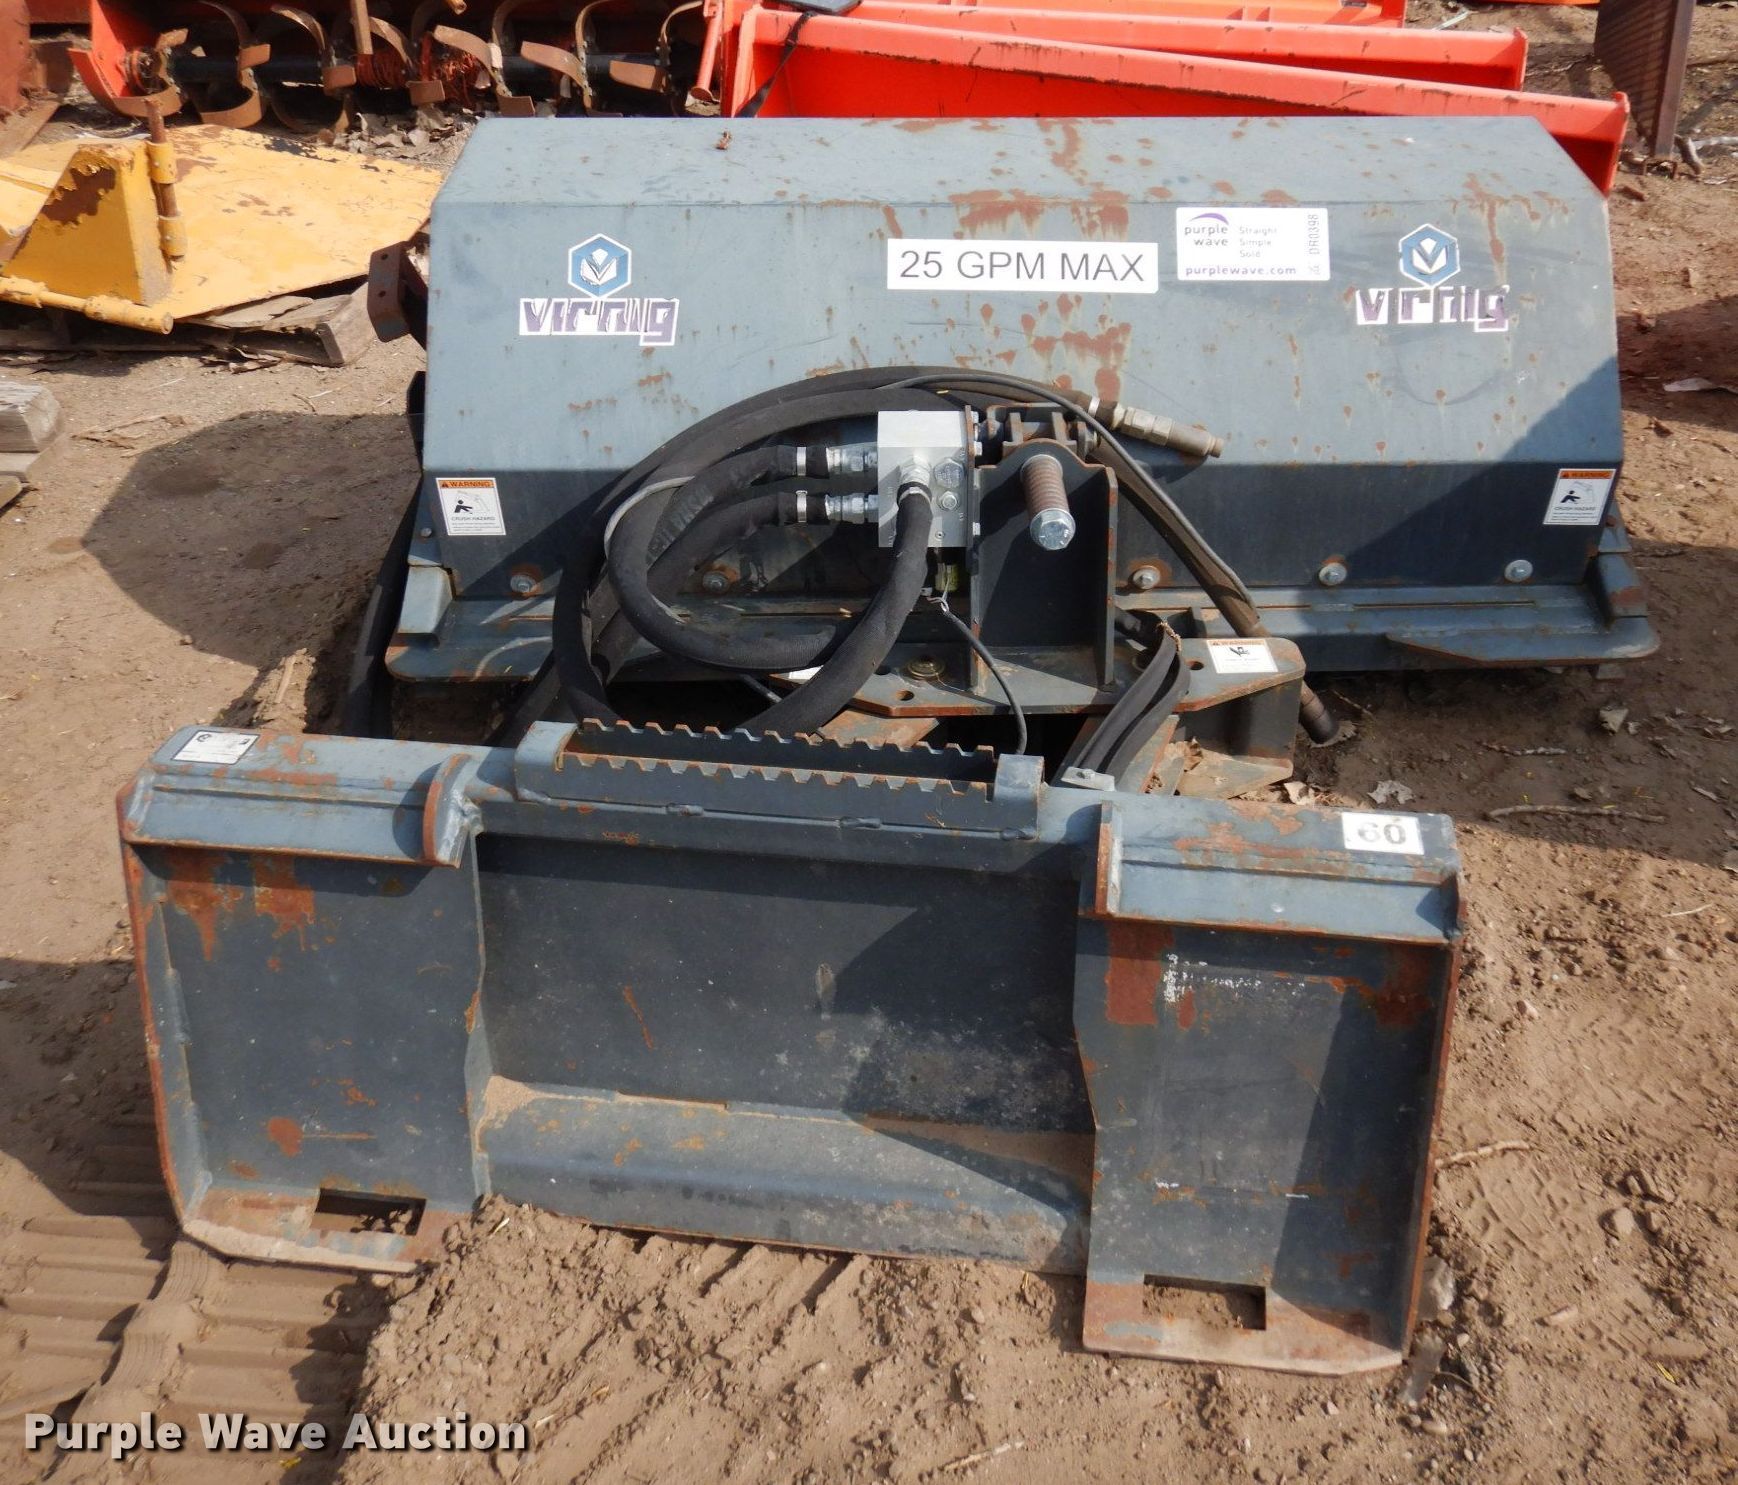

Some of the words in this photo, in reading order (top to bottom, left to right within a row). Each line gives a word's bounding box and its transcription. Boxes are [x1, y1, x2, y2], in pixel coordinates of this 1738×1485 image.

[1184, 224, 1229, 236] purple
[1239, 226, 1278, 236] Straight
[1194, 238, 1229, 246] wave
[1239, 238, 1272, 247] Simple
[1239, 249, 1261, 258] Sold
[899, 250, 943, 279] 25
[957, 251, 1045, 280] GPM
[1061, 252, 1145, 282] MAX
[1185, 264, 1297, 276] purplewave.com
[1356, 285, 1511, 333] vrnig
